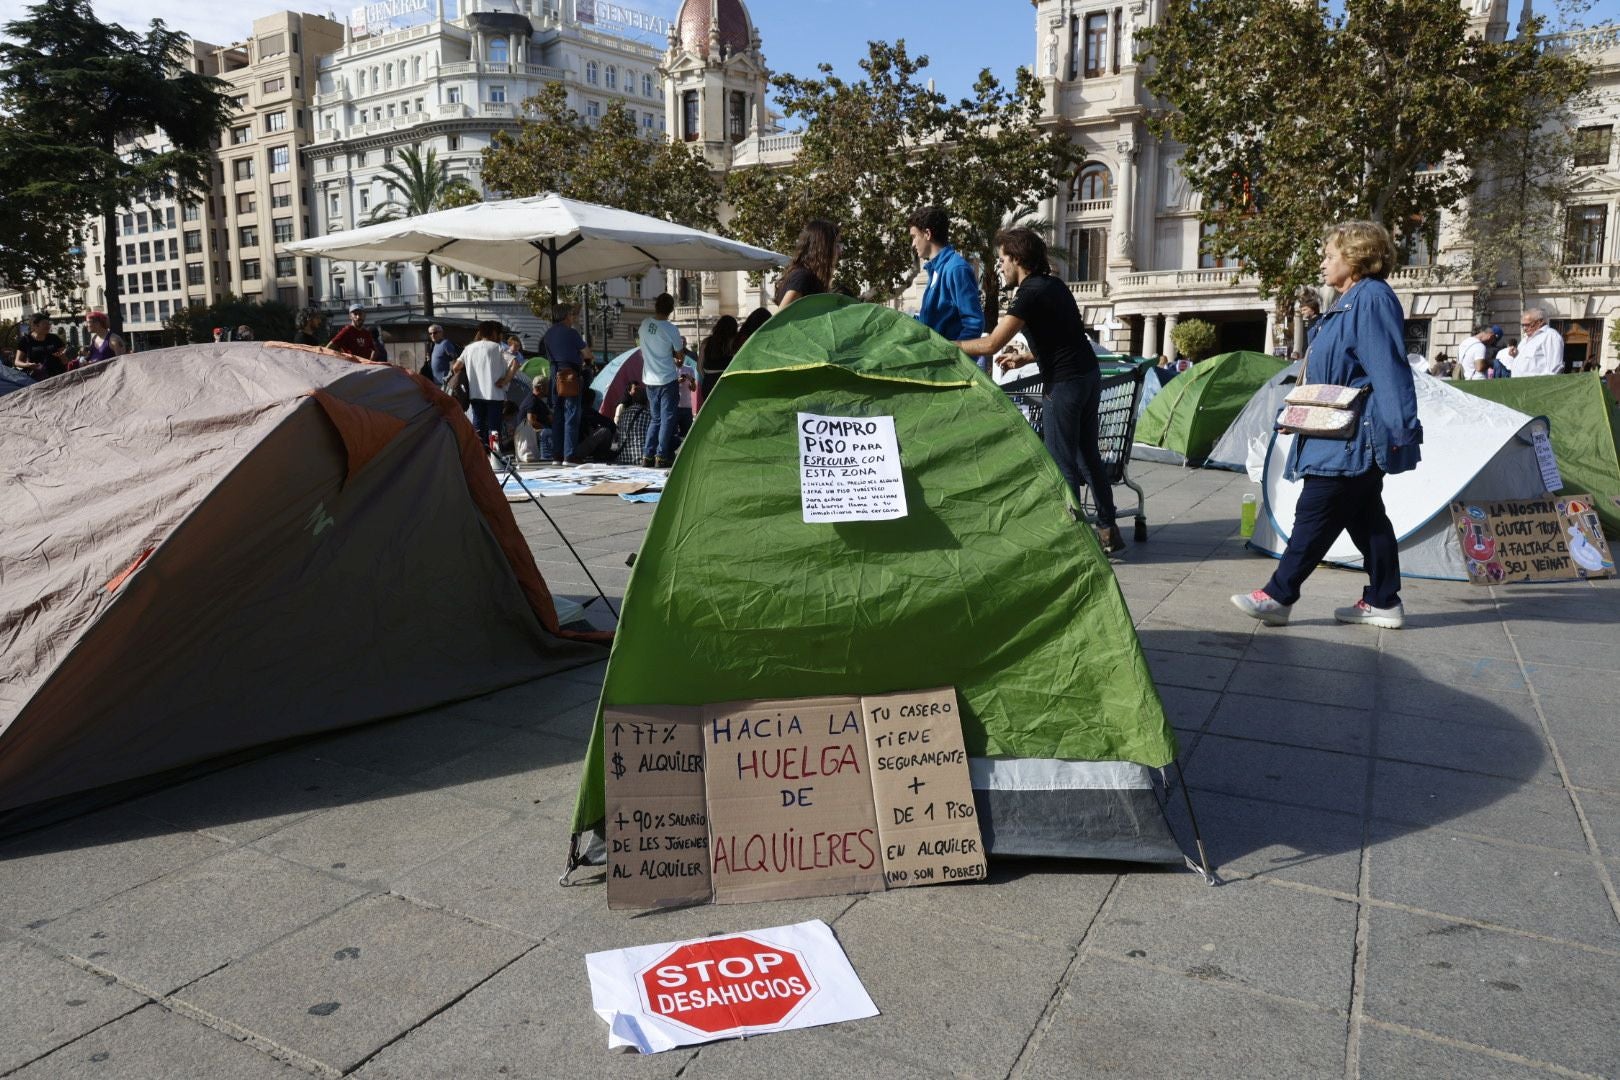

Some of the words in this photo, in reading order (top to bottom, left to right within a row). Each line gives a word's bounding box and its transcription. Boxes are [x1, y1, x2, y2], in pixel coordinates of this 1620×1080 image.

[802, 419, 877, 437] COMPRO
[852, 443, 883, 451] PARA
[803, 455, 858, 466] ESPECULAR
[861, 455, 885, 464] CON
[805, 469, 835, 478] ESTA
[840, 467, 877, 477] ZONA
[1490, 504, 1505, 517] LA
[1507, 501, 1556, 516] NOSTRA
[1498, 542, 1508, 557] A
[1509, 540, 1555, 556] FALTAR
[1557, 541, 1569, 552] EL
[1505, 560, 1527, 575] SEU
[870, 706, 890, 724] TU
[900, 702, 952, 717] CASERO
[828, 710, 859, 736] LA
[611, 752, 626, 780] $
[738, 744, 860, 781] HUELGA
[878, 749, 965, 771] SEGURAMENTE
[780, 787, 814, 807] DE
[893, 806, 914, 825] DE
[924, 802, 934, 821] 1
[612, 838, 631, 853] DE
[639, 836, 660, 852] LES
[887, 844, 906, 860] EN
[612, 863, 632, 879] AL
[887, 869, 908, 884] (NO
[913, 867, 934, 880] SON
[942, 864, 986, 880] POBRES)
[656, 952, 784, 988] STOP
[656, 975, 807, 1014] DESAHUCIOS
